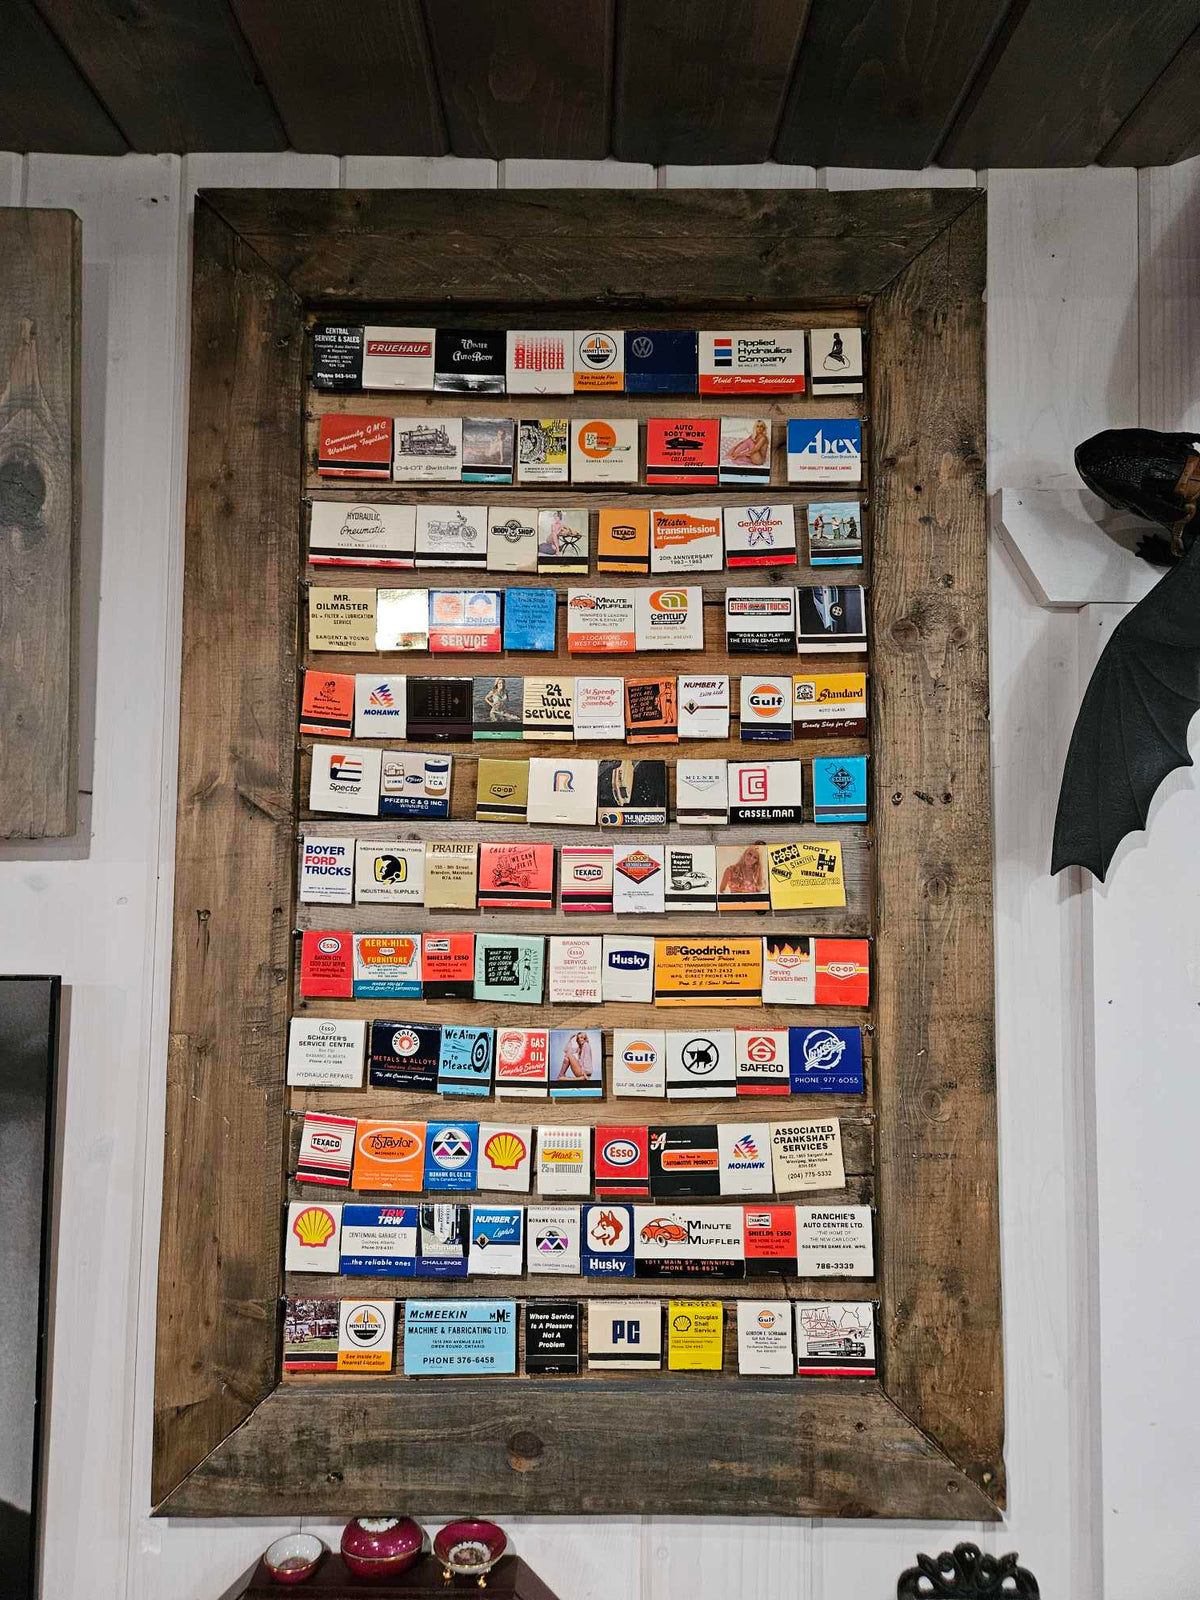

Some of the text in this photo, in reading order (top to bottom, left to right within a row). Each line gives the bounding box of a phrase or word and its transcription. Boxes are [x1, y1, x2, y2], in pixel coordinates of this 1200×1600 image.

[325, 327, 349, 335] CENTRAL
[343, 336, 360, 344] SALES
[738, 339, 775, 347] Applied
[369, 344, 428, 353] FRUEHAUF
[738, 347, 792, 355] Hydraulics
[738, 356, 787, 364] Company
[713, 376, 731, 384] Fluid
[734, 376, 756, 384] Power
[327, 434, 389, 455] Working Together
[346, 512, 381, 521] HYDRAULIC
[657, 517, 687, 526] Mister
[737, 520, 783, 528] Generation
[340, 525, 385, 535] Pneumatic
[656, 525, 716, 535] transmission
[730, 602, 789, 610] STERN TRUCKS
[650, 613, 687, 623] century
[441, 634, 488, 647] SERVICE
[718, 681, 724, 689] 7
[546, 684, 562, 696] 24
[817, 688, 863, 702] Standard
[541, 695, 572, 707] hour
[750, 696, 783, 705] Gulf
[525, 707, 571, 719] service
[329, 783, 361, 792] Spector
[739, 809, 794, 818] CASSELMAN
[624, 814, 665, 823] THUNDERBIRD
[306, 845, 345, 856] BOYER
[432, 844, 474, 853] PRAIRIE
[305, 855, 337, 865] FORD
[305, 865, 351, 876] TRUCKS
[665, 945, 730, 956] BFGoodrich
[612, 954, 647, 966] Husky
[444, 1029, 476, 1040] We Aim
[530, 1038, 545, 1048] GAS
[373, 1055, 437, 1066] METALS ALLOYS
[530, 1052, 544, 1062] OIL
[624, 1052, 655, 1062] Gulf
[442, 1060, 472, 1070] Please
[740, 1064, 783, 1072] SAFECO
[775, 1126, 833, 1135] ASSOCIATED
[312, 1137, 340, 1148] TEXACO
[774, 1134, 836, 1144] CRANKSHAFT
[609, 1147, 633, 1157] Esso
[783, 1143, 828, 1152] SERVICES
[787, 1172, 803, 1180] (204)
[381, 1208, 405, 1217] TRW
[378, 1216, 404, 1225] TRW
[475, 1215, 518, 1225] NUMBER 7
[590, 1258, 626, 1271] Husky
[409, 1310, 468, 1319] McMEEKIN
[447, 1327, 492, 1335] FABRICATING
[612, 1320, 640, 1344] PC
[423, 1356, 495, 1364] PHONE 376-6458
